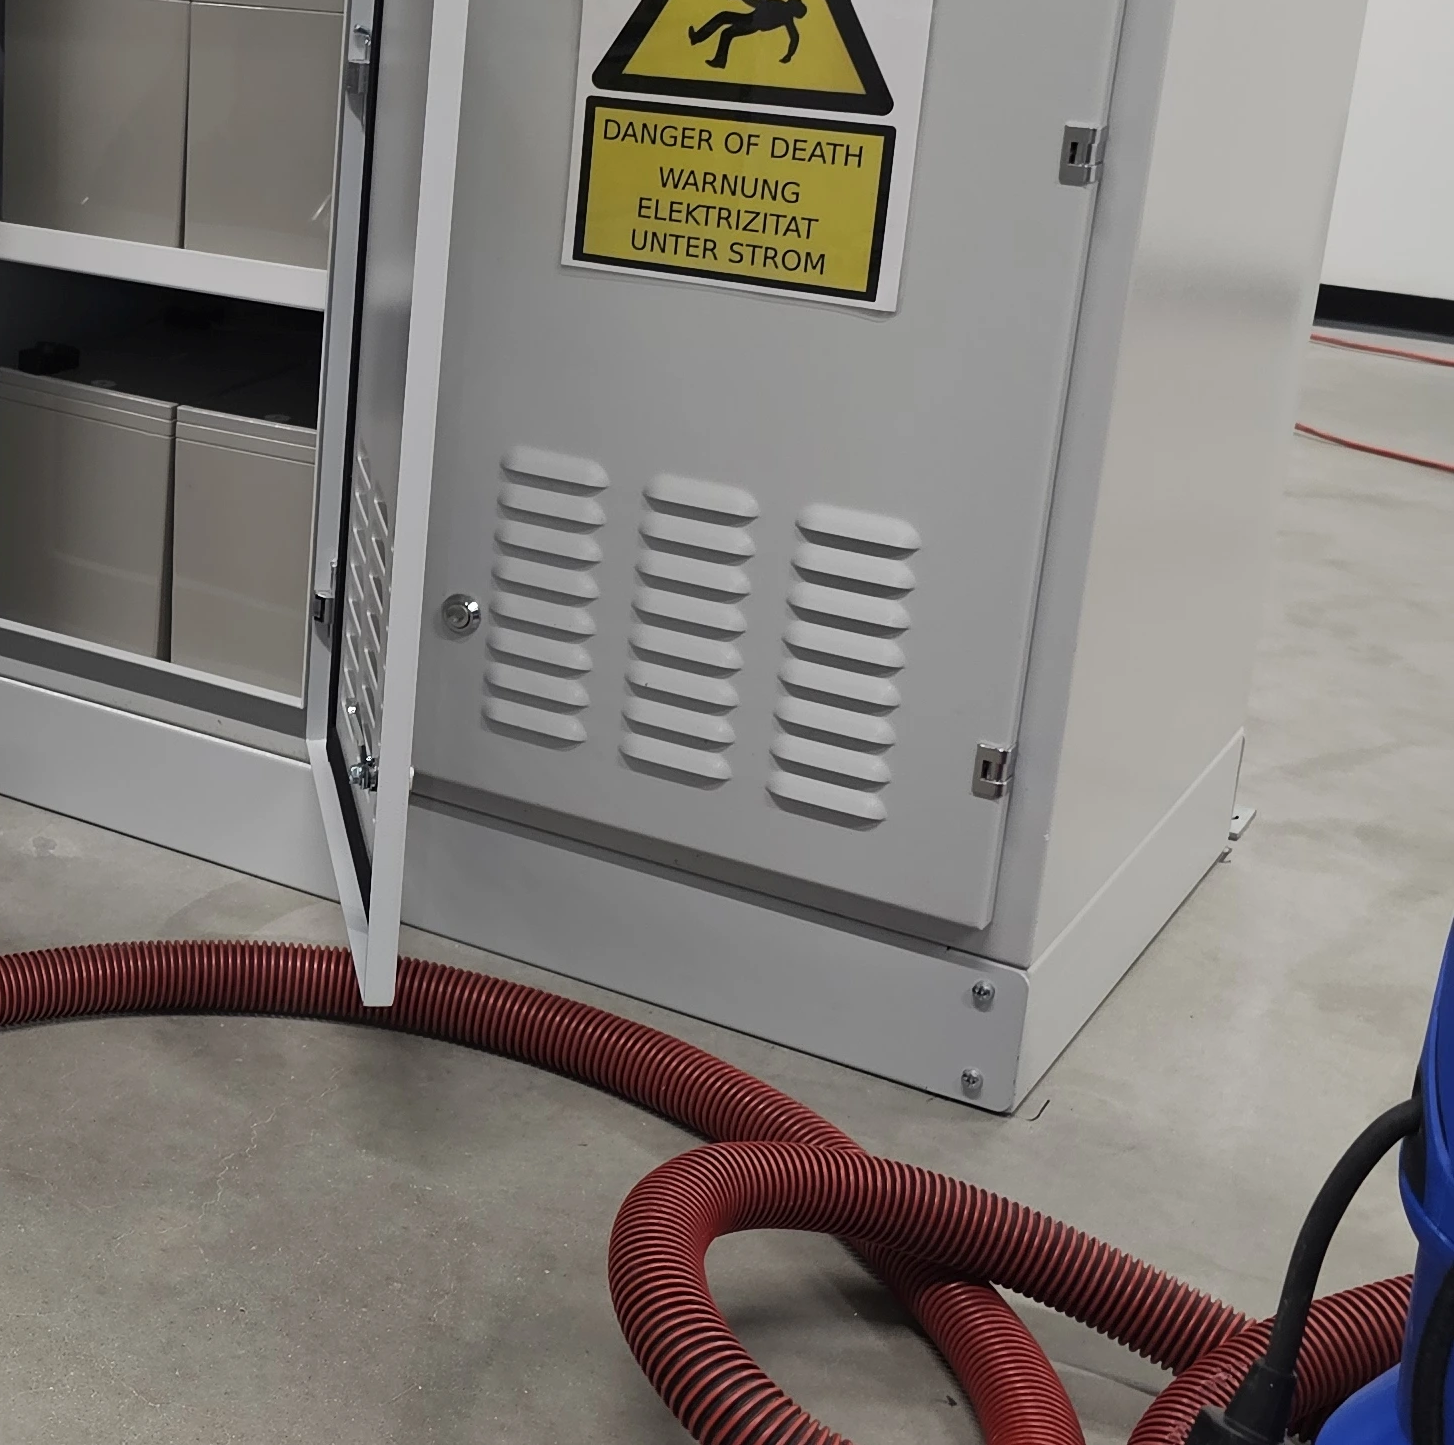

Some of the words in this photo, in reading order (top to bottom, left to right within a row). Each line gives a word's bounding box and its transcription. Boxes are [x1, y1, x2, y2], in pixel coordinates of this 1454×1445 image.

[602, 118, 714, 153] DANGER
[724, 131, 760, 156] OF
[770, 137, 864, 169] DEATH
[659, 166, 801, 204] WARNUNG
[637, 197, 819, 240] ELEKTRIZITAT
[631, 228, 718, 261] UNTER
[728, 242, 826, 276] STROM
